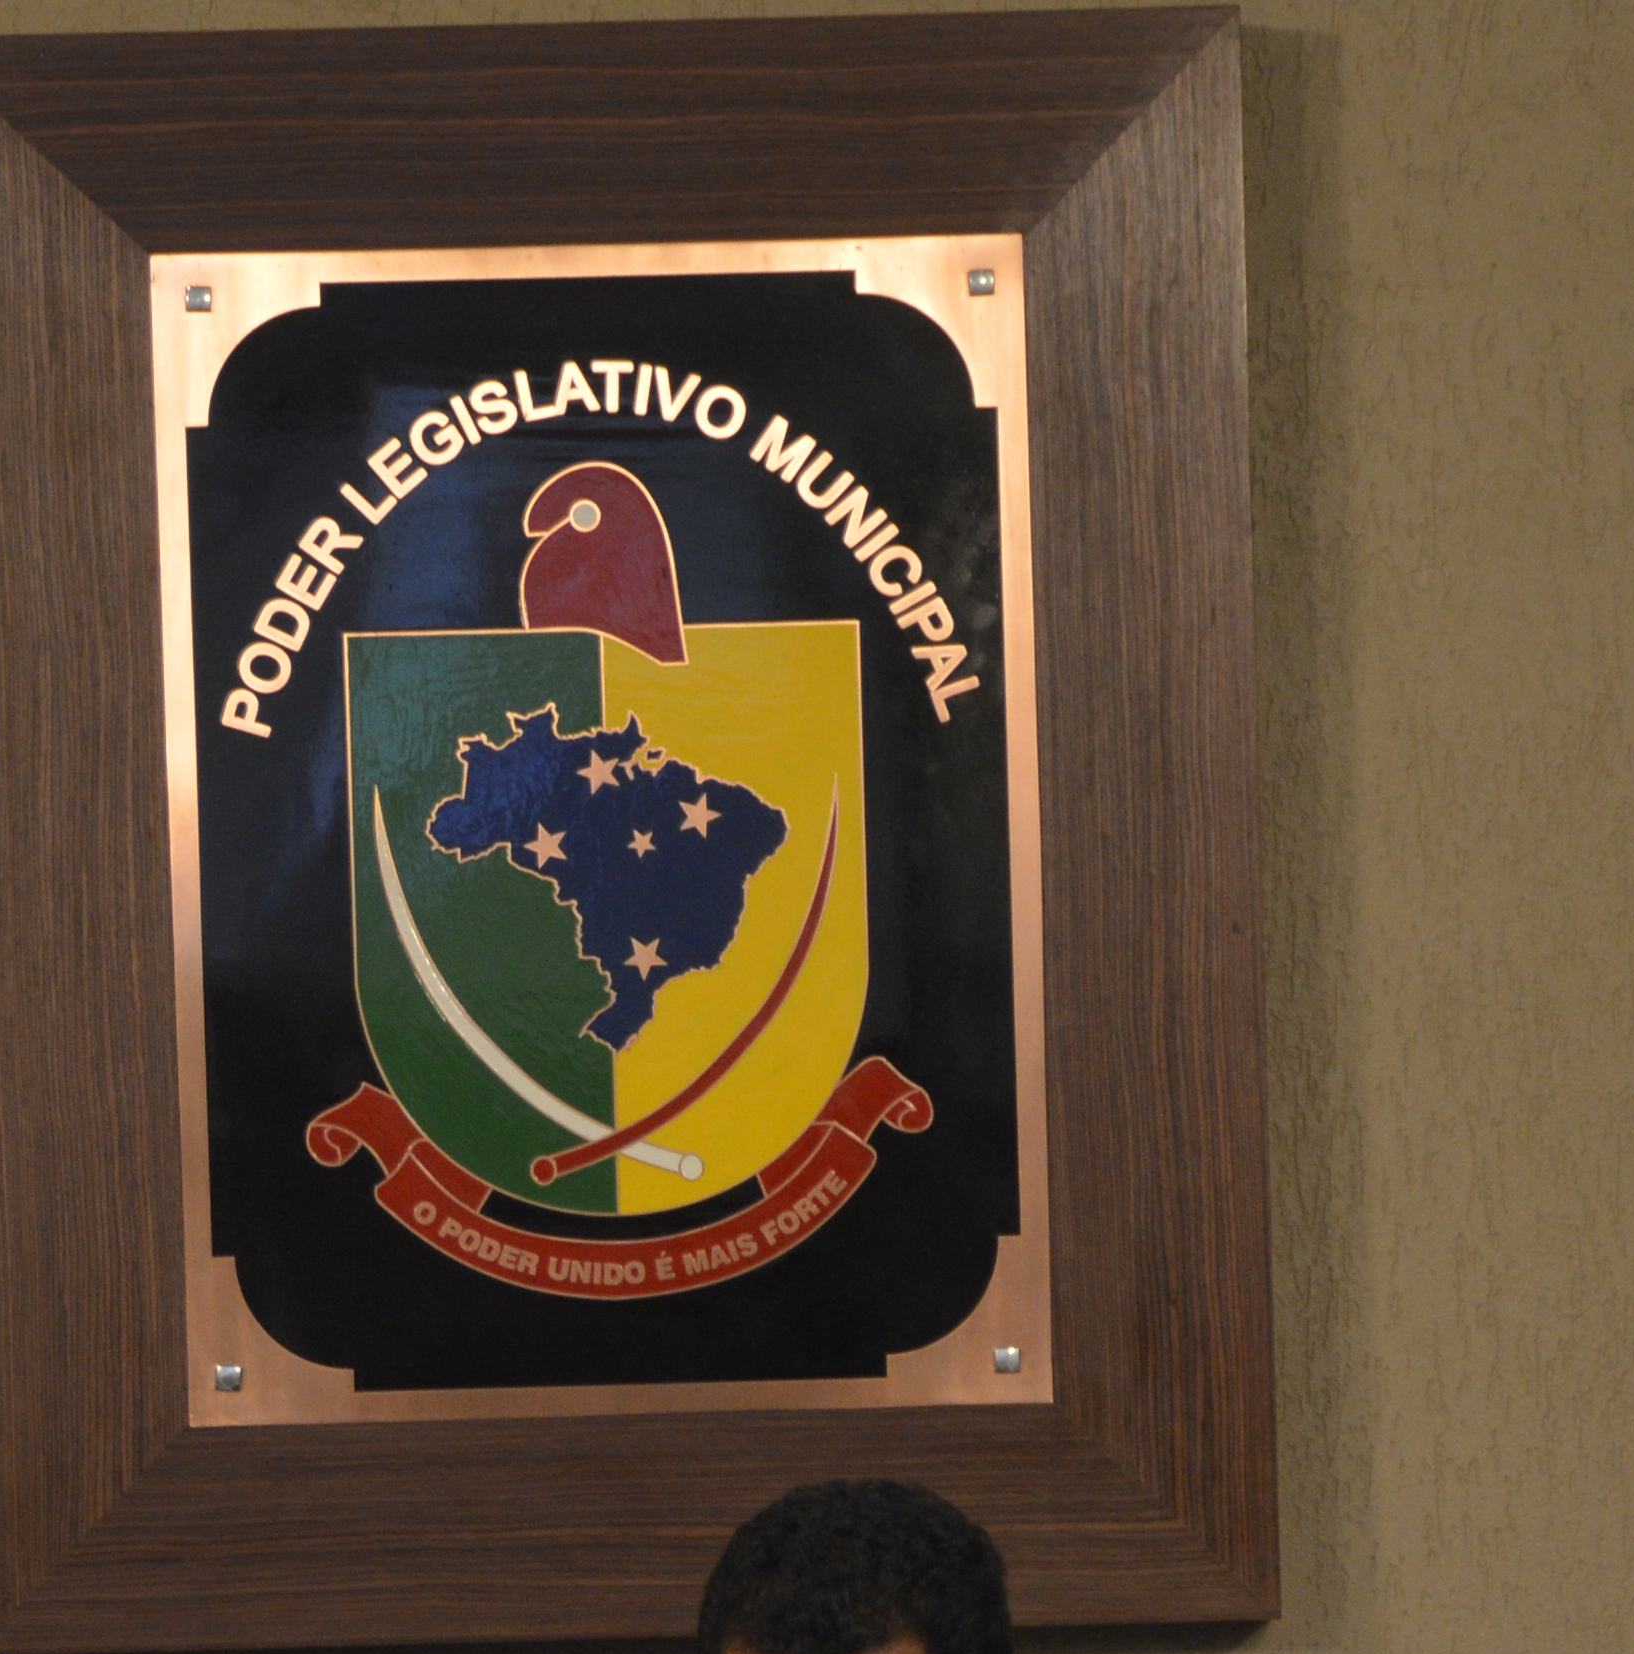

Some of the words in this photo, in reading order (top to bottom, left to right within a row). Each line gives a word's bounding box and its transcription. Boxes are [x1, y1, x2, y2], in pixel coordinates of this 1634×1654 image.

[221, 515, 363, 738] PODER
[340, 360, 747, 526] LEGISLATIVO
[750, 415, 980, 723] MUNICIPAL
[414, 1201, 436, 1226] O
[439, 1217, 539, 1276] PODER
[548, 1256, 646, 1286] UNIDO
[655, 1251, 675, 1280] É
[682, 1233, 759, 1275] MAIS
[760, 1169, 848, 1246] FORTE
